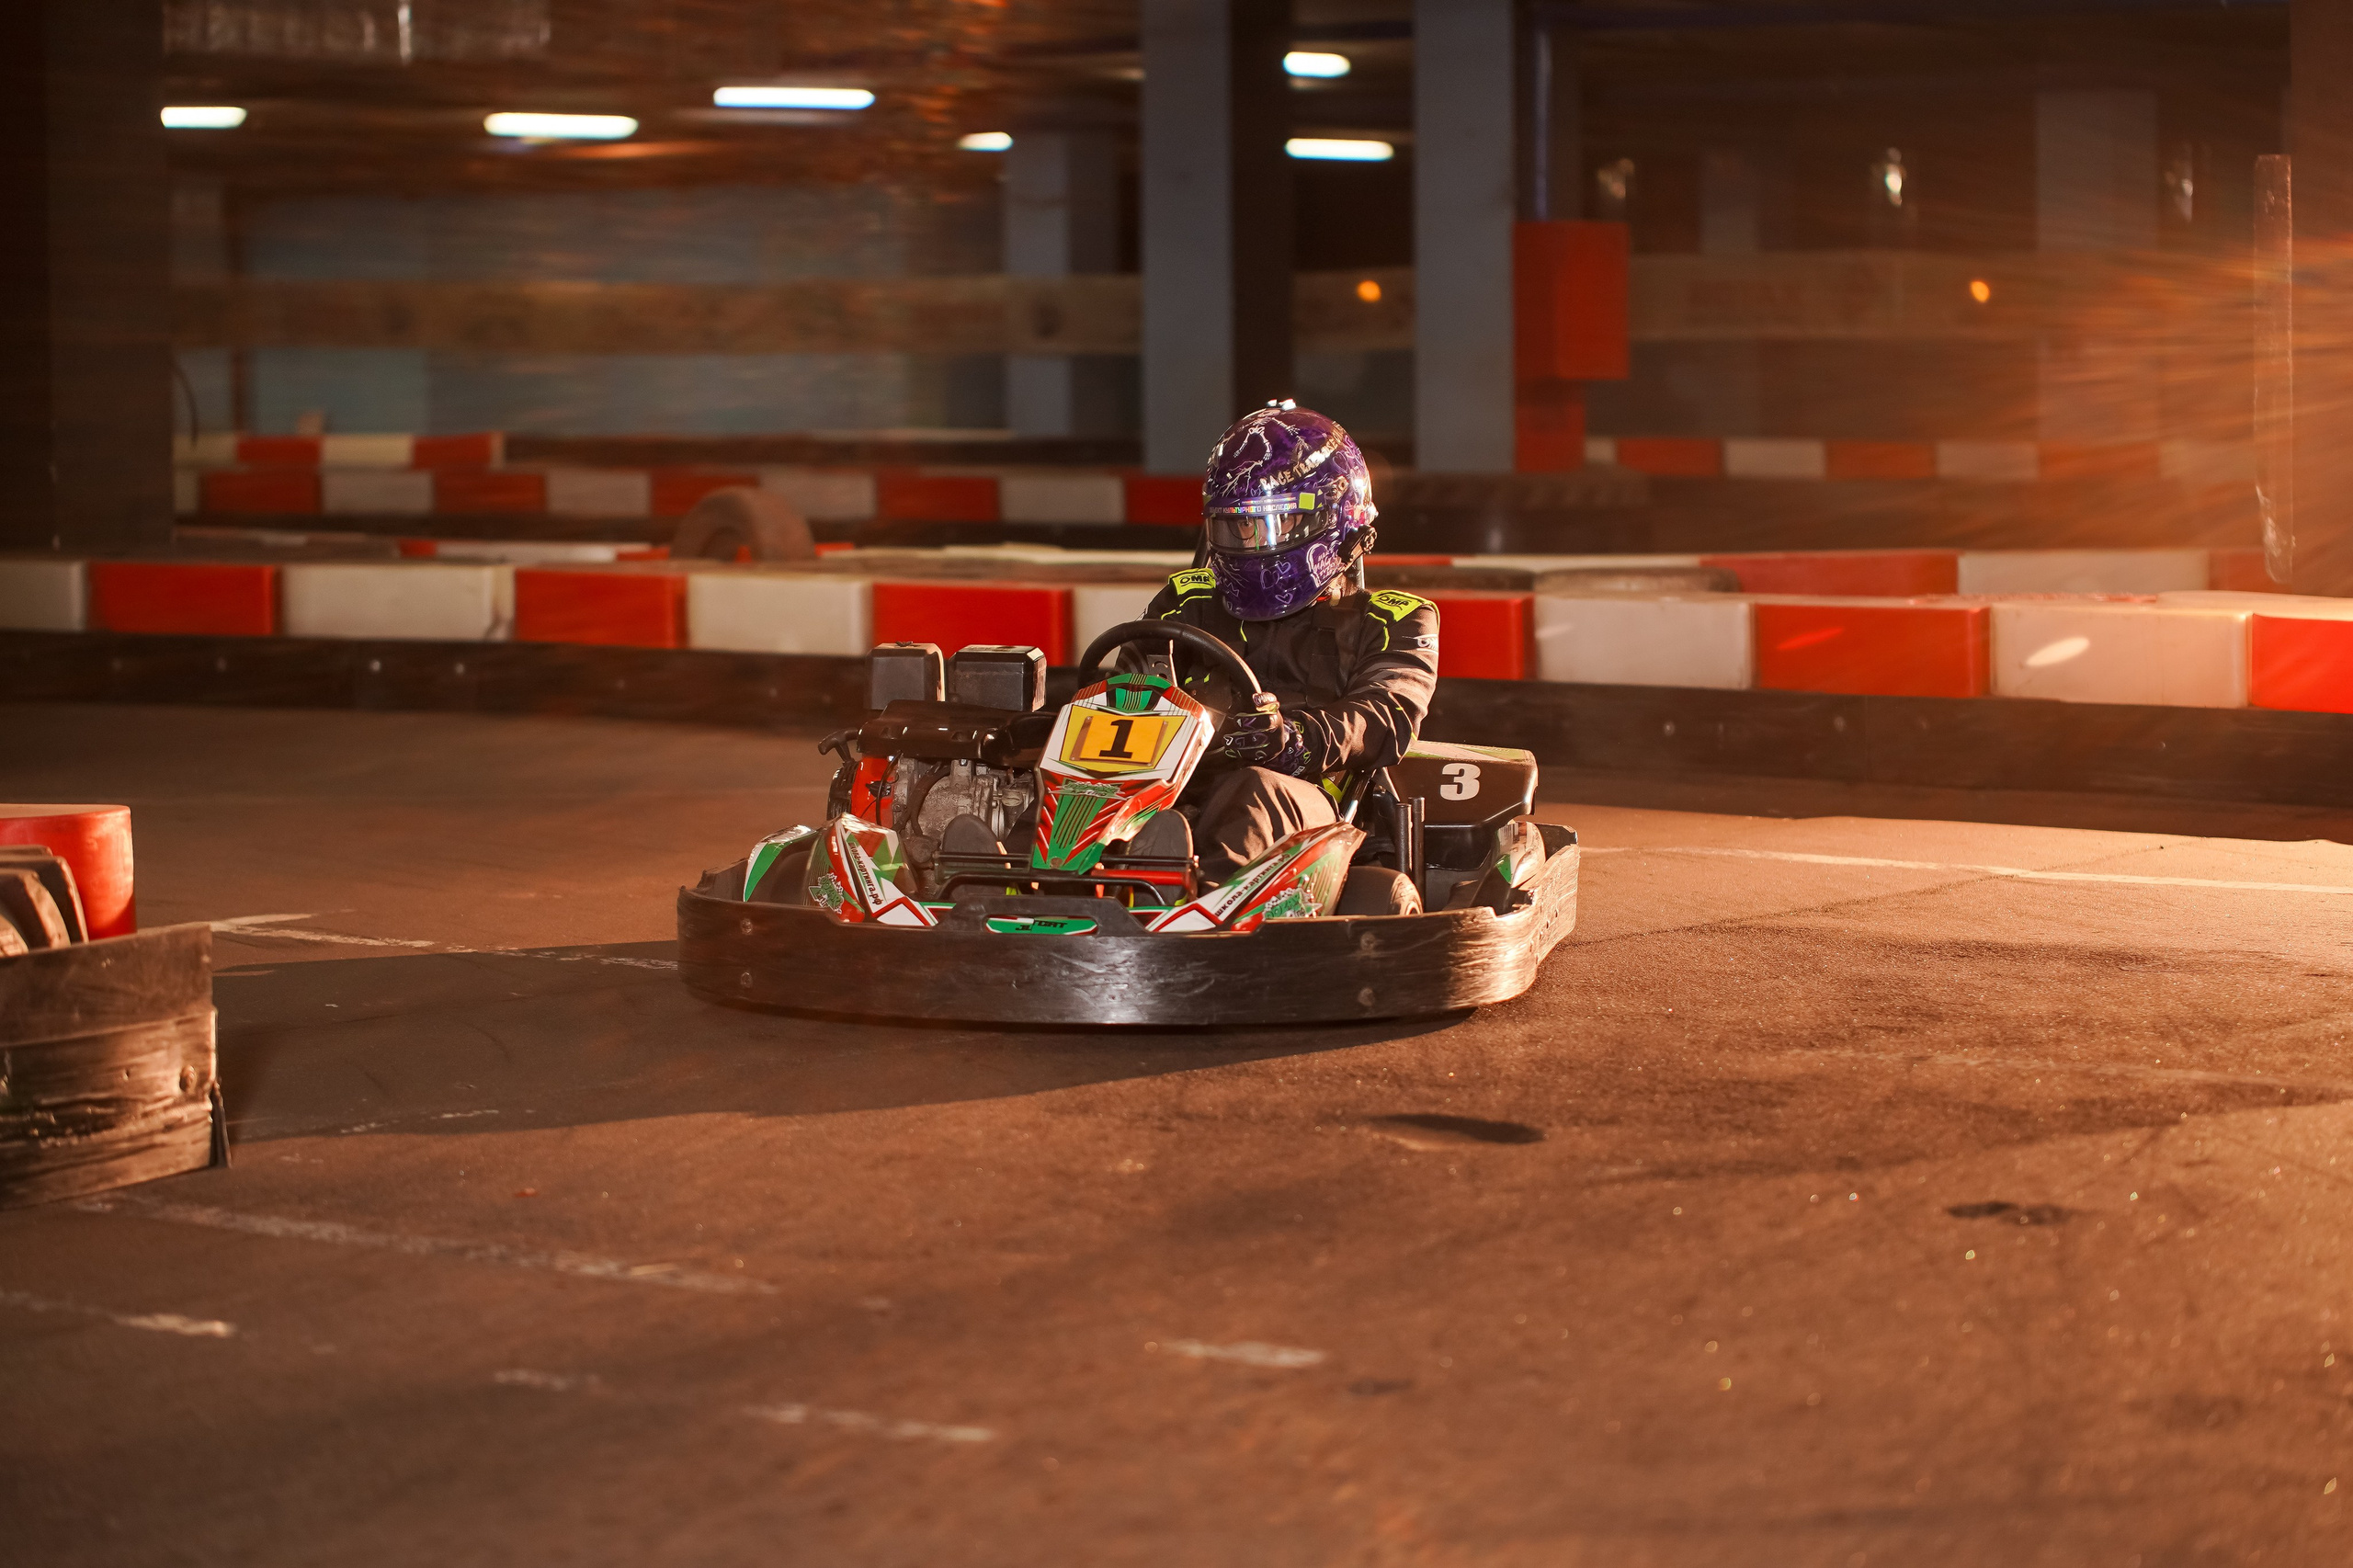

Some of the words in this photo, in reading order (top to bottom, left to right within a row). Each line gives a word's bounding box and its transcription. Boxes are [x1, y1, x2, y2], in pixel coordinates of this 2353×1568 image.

[1259, 469, 1294, 488] RACE
[1179, 574, 1210, 585] OMP
[1379, 595, 1410, 607] OMP
[1098, 719, 1134, 759] 1
[1439, 762, 1482, 801] 3
[848, 841, 884, 905] школа-картинга.рф
[1214, 853, 1291, 917] школа-картинга.рф
